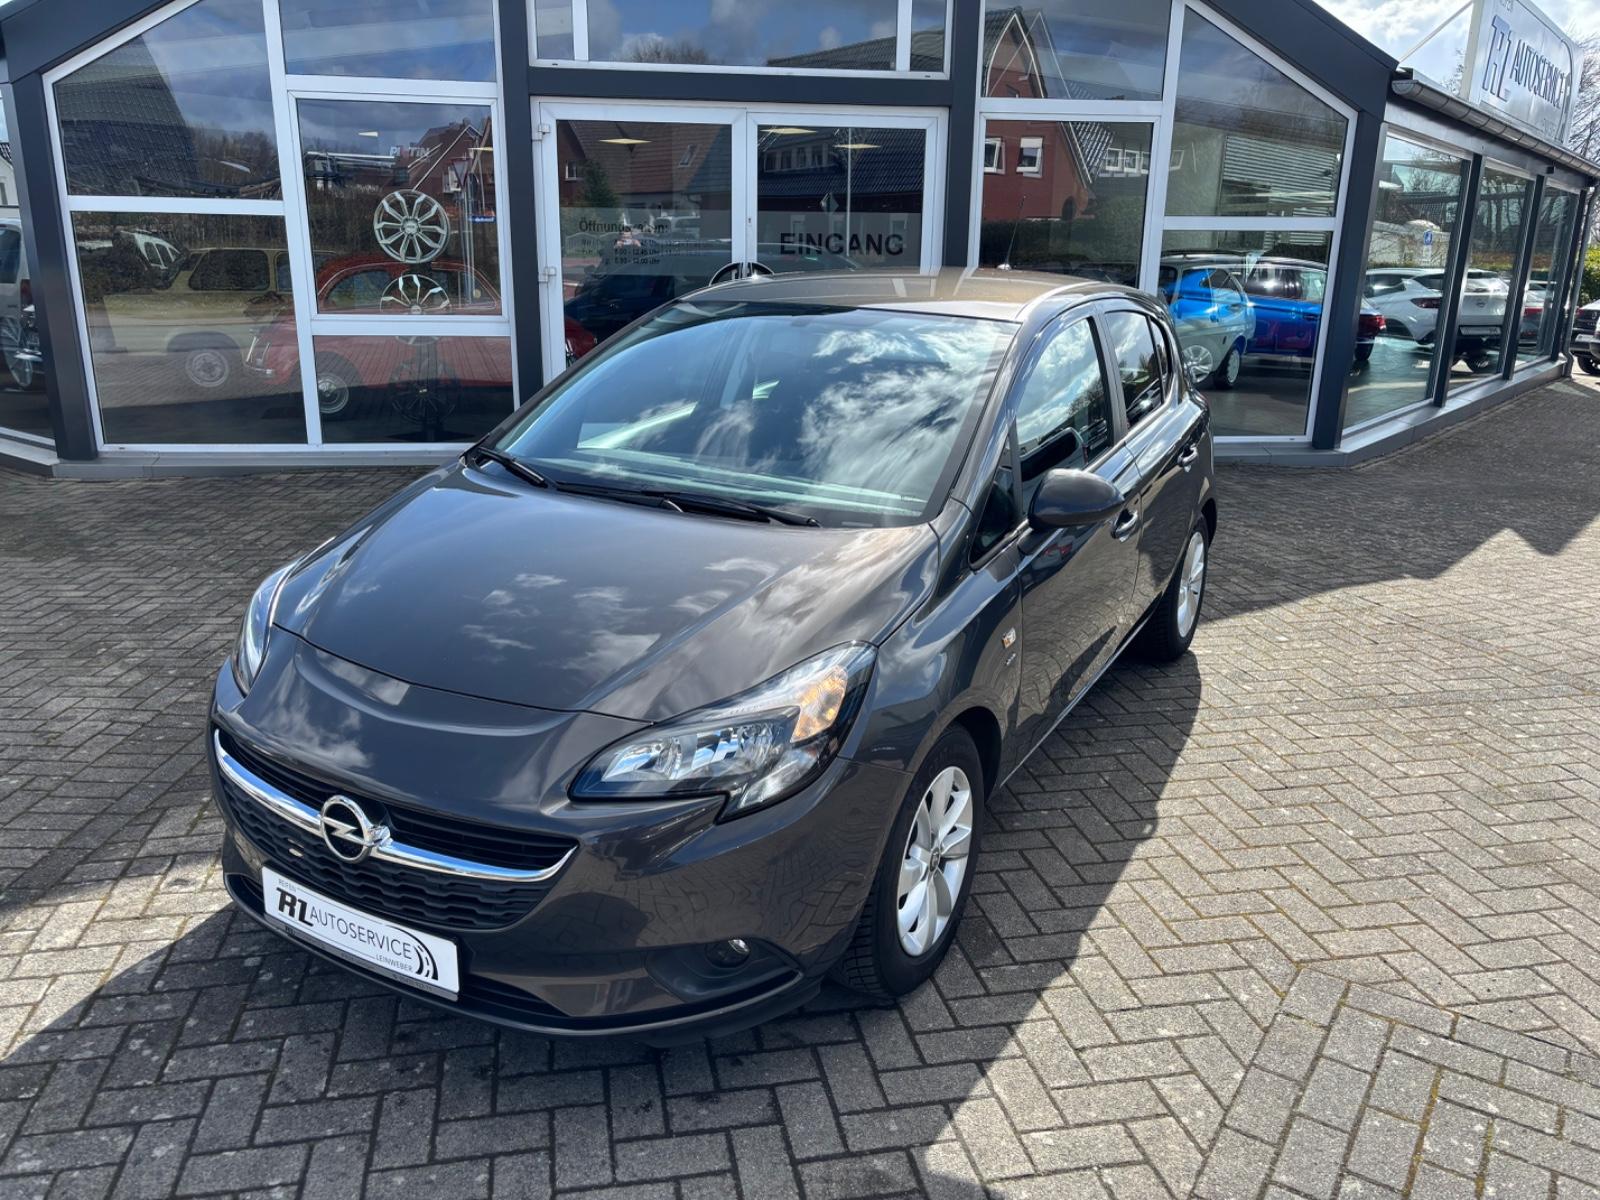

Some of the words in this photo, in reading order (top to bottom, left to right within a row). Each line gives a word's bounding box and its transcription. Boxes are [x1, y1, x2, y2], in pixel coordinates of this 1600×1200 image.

[780, 232, 904, 256] EINGANG
[309, 905, 413, 961] AUTOSERVICE
[375, 953, 415, 974] LEINWEBER
